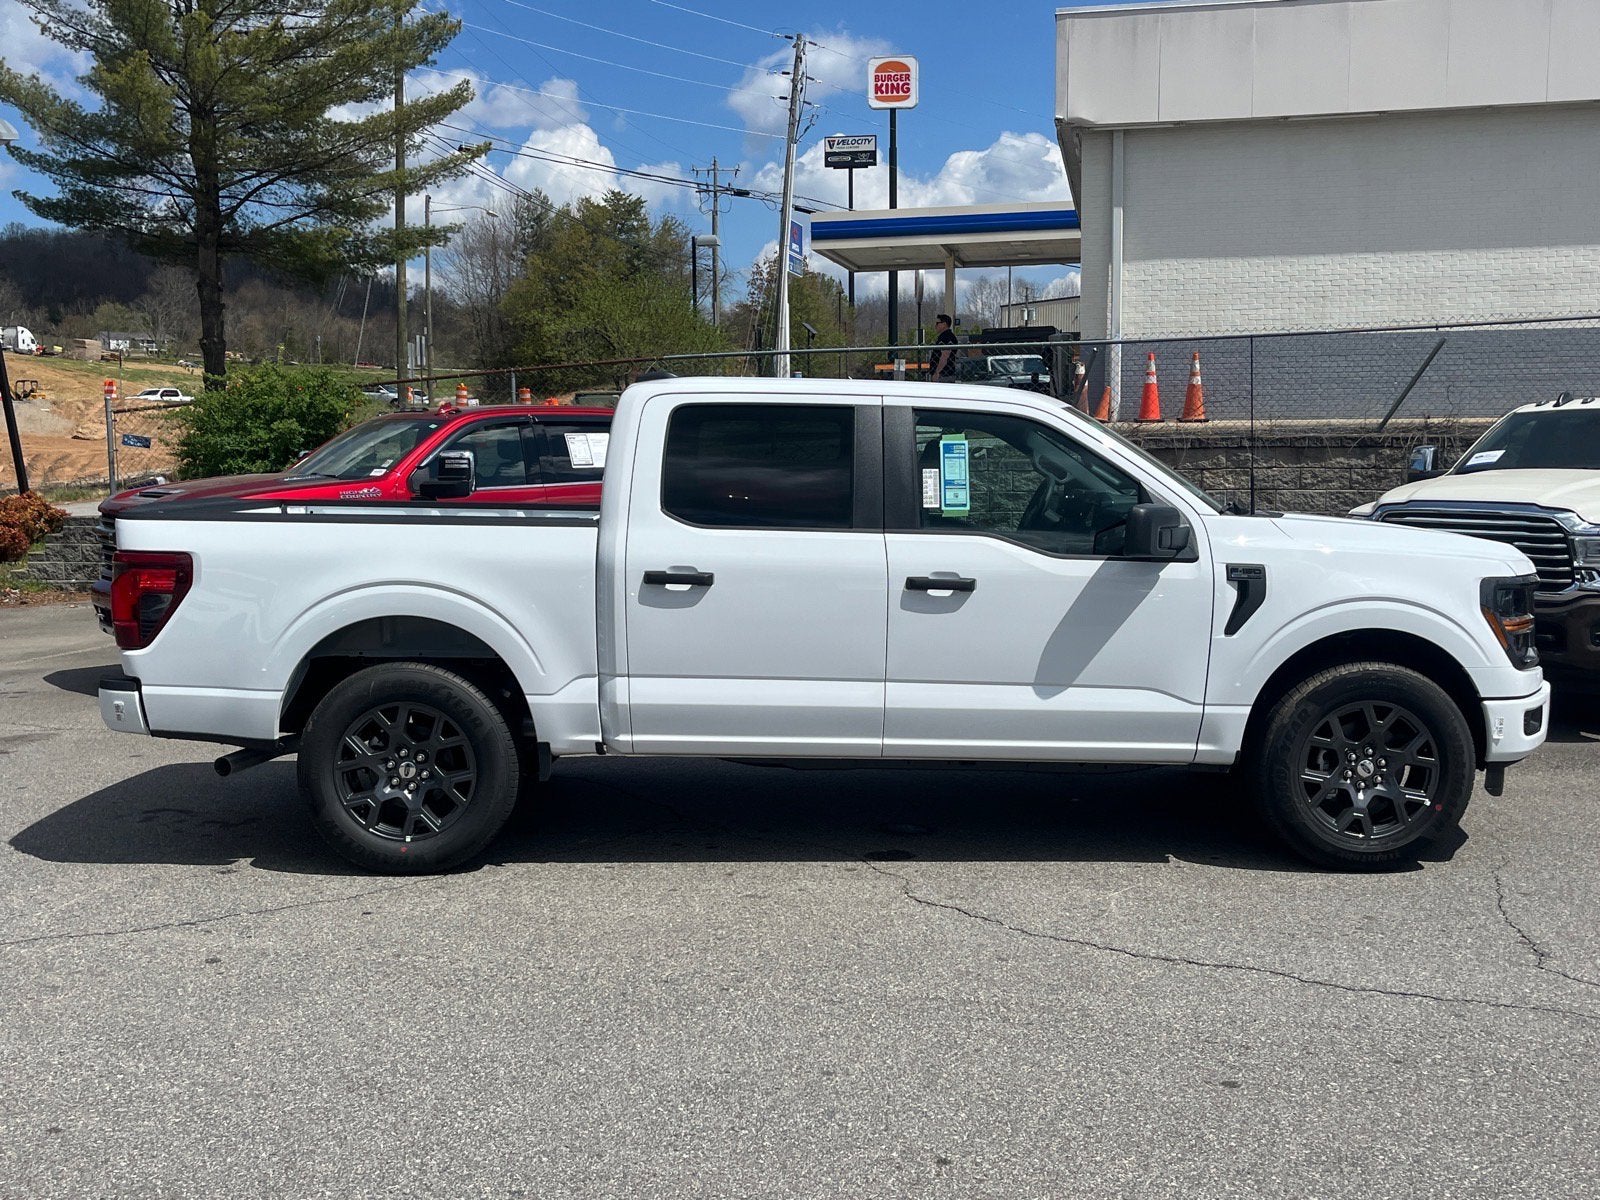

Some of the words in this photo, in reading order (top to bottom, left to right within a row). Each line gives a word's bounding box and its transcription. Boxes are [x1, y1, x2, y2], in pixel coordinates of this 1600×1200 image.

[874, 73, 911, 83] BURGER
[874, 82, 911, 95] KING
[836, 138, 874, 146] VELOCITY
